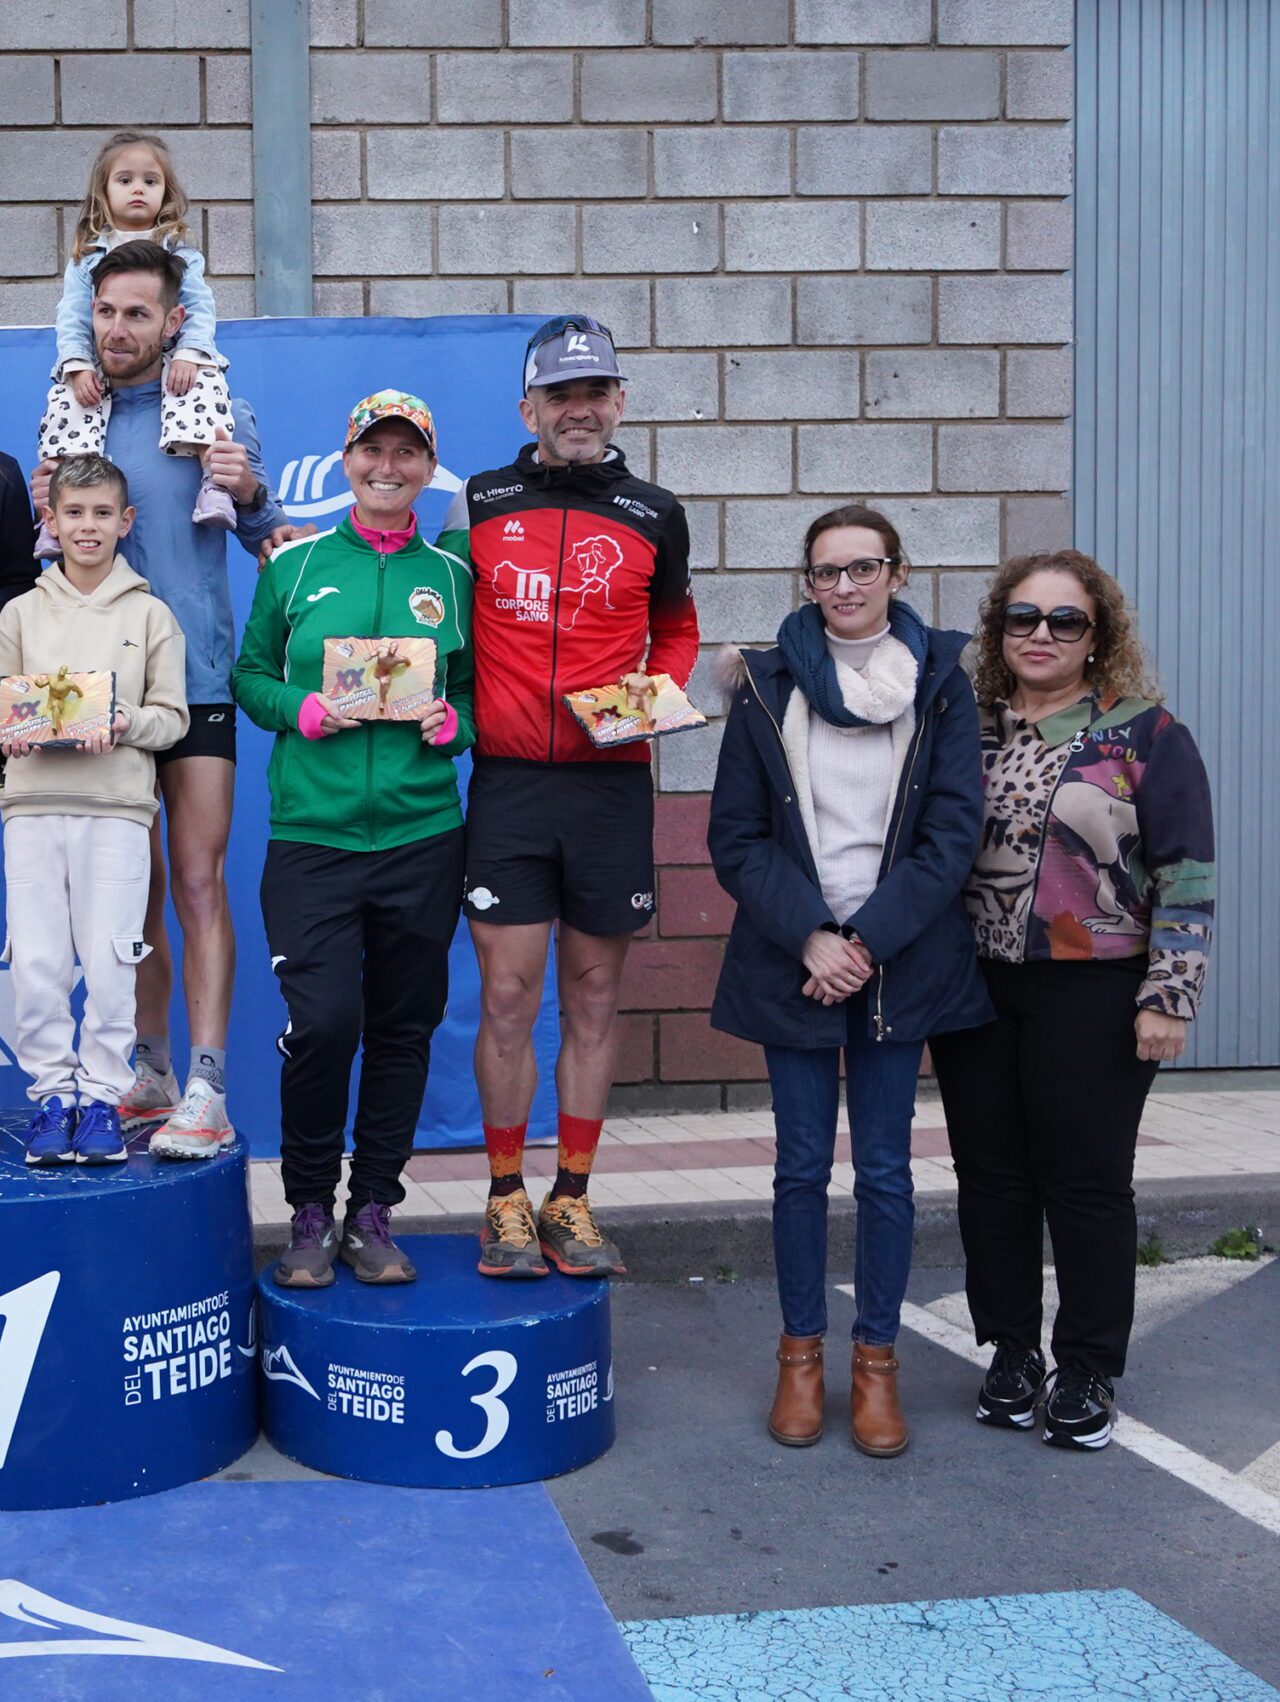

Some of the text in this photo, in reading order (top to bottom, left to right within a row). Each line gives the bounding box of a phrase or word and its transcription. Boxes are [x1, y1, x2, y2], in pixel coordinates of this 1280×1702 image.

[495, 598, 549, 611] CORPORE
[516, 610, 549, 622] SANO
[123, 1310, 230, 1362] SANTIAGO
[144, 1338, 232, 1400] TEIDE
[124, 1366, 141, 1406] DEL
[327, 1391, 337, 1411] DEL
[328, 1373, 405, 1401] SANTIAGO
[546, 1371, 598, 1400] SANTIAGO
[338, 1391, 405, 1424] TEIDE
[435, 1350, 518, 1459] 3
[546, 1400, 555, 1423] DEL
[556, 1387, 598, 1420] TEIDE
